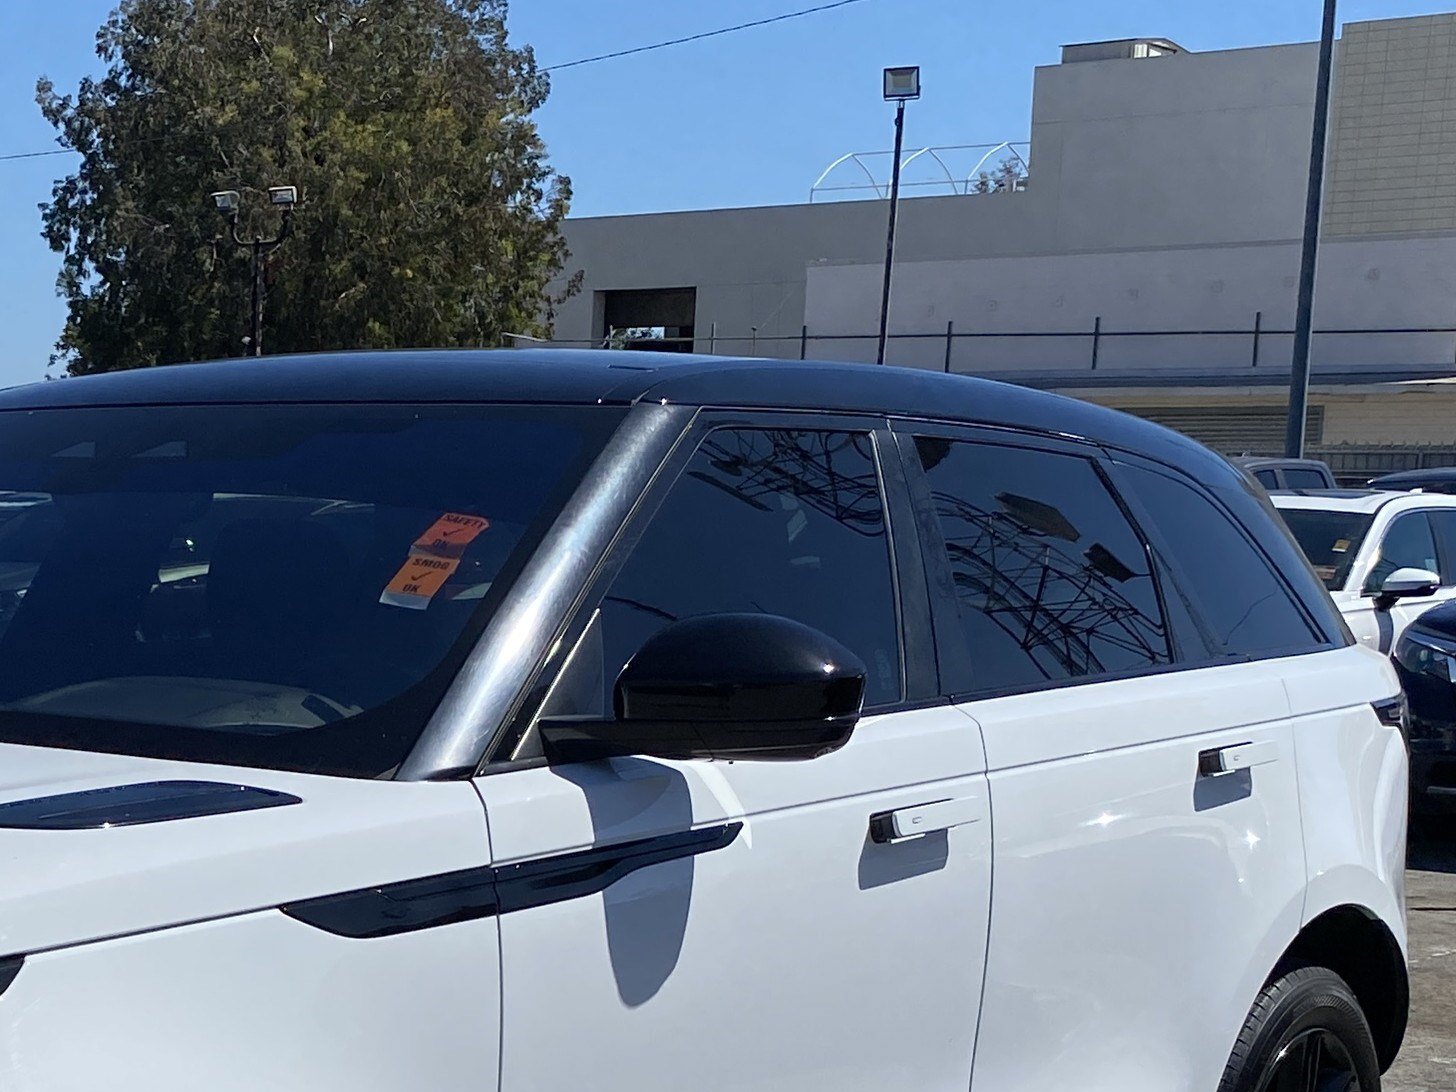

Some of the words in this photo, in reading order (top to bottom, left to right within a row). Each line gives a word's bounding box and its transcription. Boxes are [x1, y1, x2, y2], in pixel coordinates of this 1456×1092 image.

[445, 514, 486, 529] SAFETY
[412, 558, 450, 571] SMOG
[402, 584, 422, 593] OK
